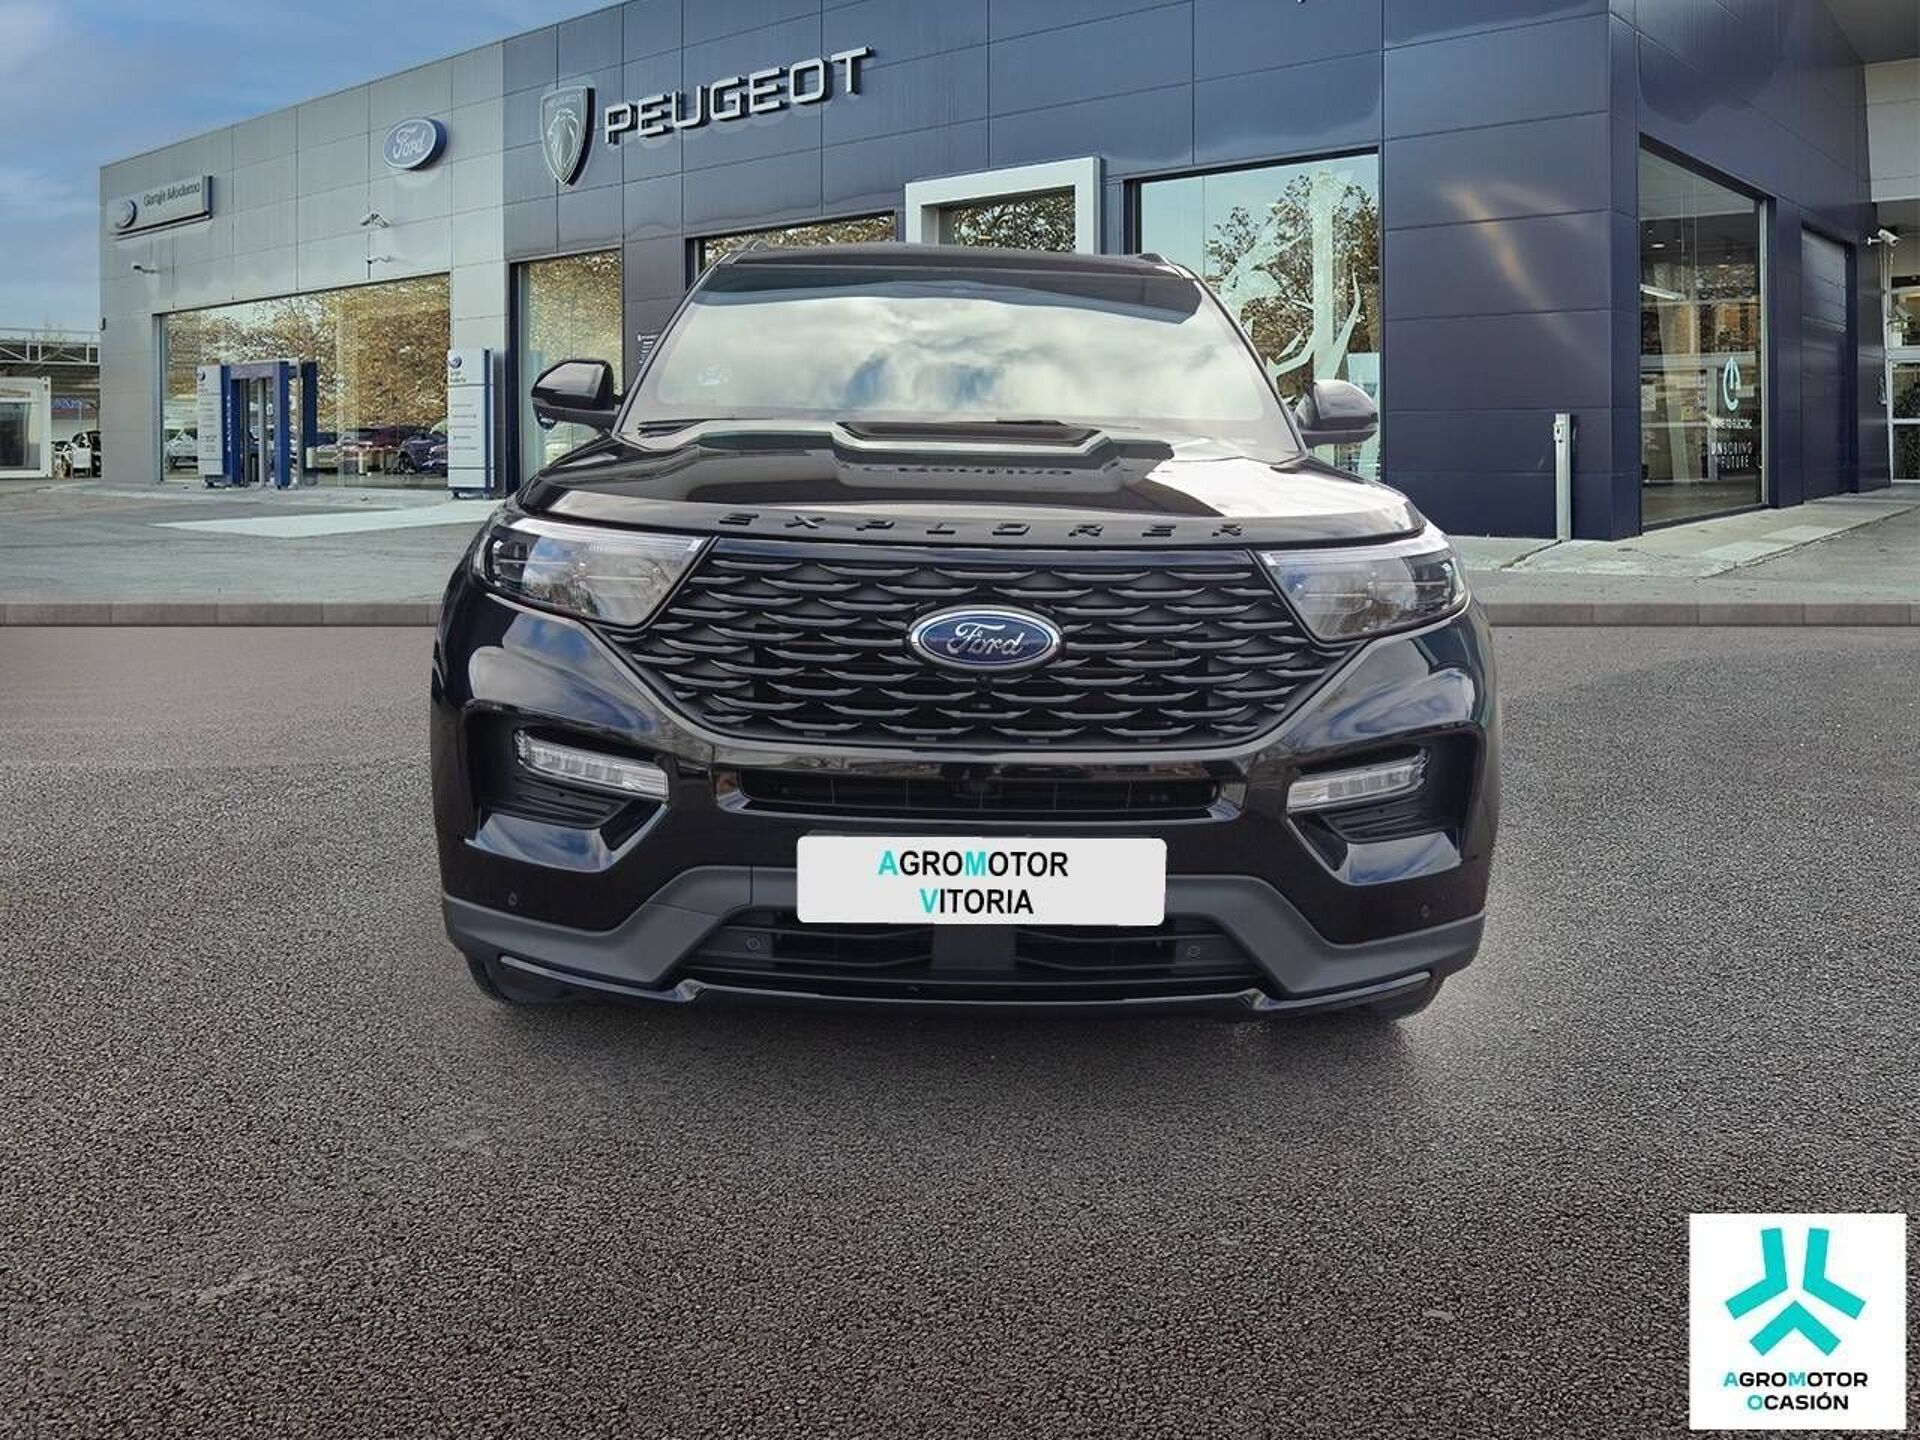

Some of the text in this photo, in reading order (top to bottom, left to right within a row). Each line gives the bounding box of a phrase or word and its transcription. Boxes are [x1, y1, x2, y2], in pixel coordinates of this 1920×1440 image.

[604, 46, 870, 144] PEUGEOT
[392, 124, 426, 159] Ford
[718, 513, 1247, 537] EXPLORER
[947, 622, 1025, 657] Ford
[877, 850, 1069, 877] AGROMOTOR
[919, 888, 1034, 915] VITORIA
